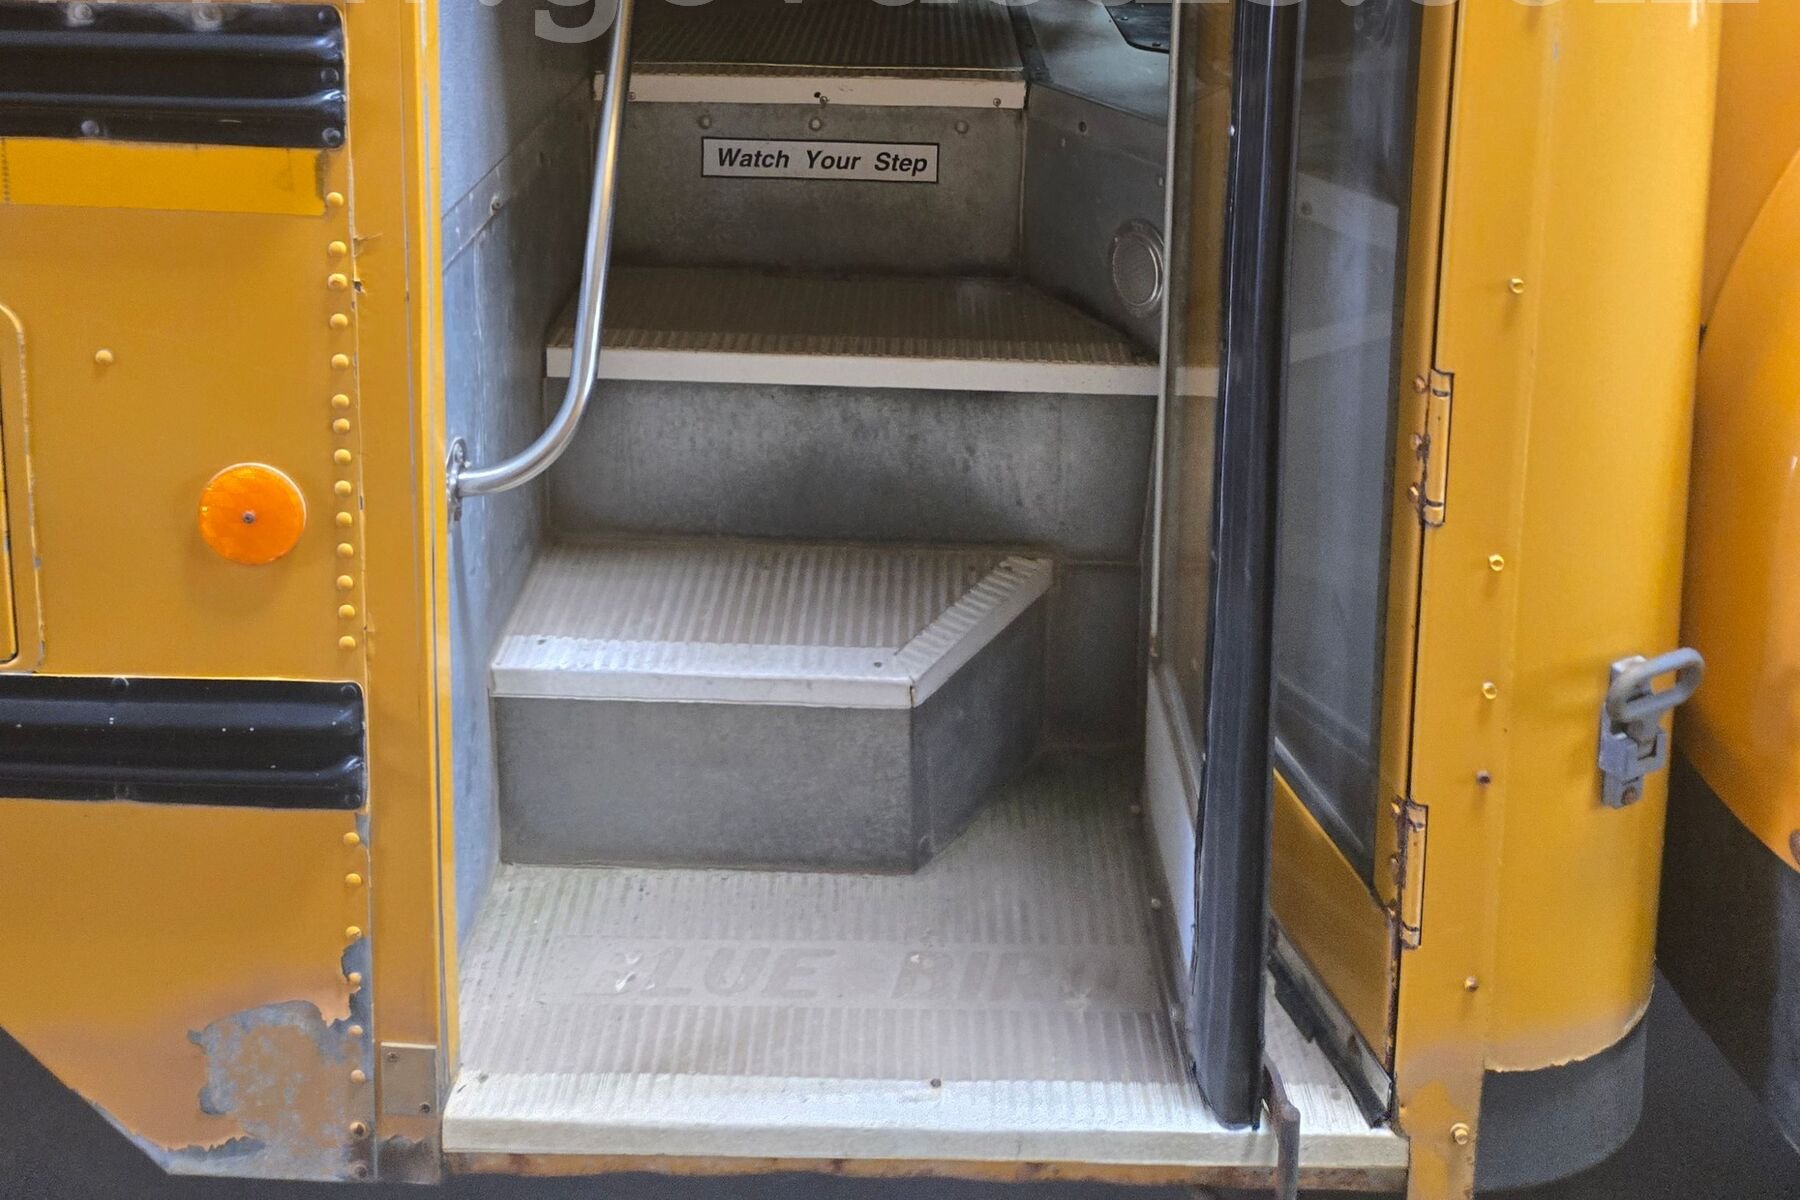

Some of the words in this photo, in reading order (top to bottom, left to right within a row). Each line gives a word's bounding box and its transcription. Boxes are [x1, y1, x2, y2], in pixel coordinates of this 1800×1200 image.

[718, 148, 789, 169] Watch
[807, 150, 861, 170] Your
[874, 152, 928, 176] Step
